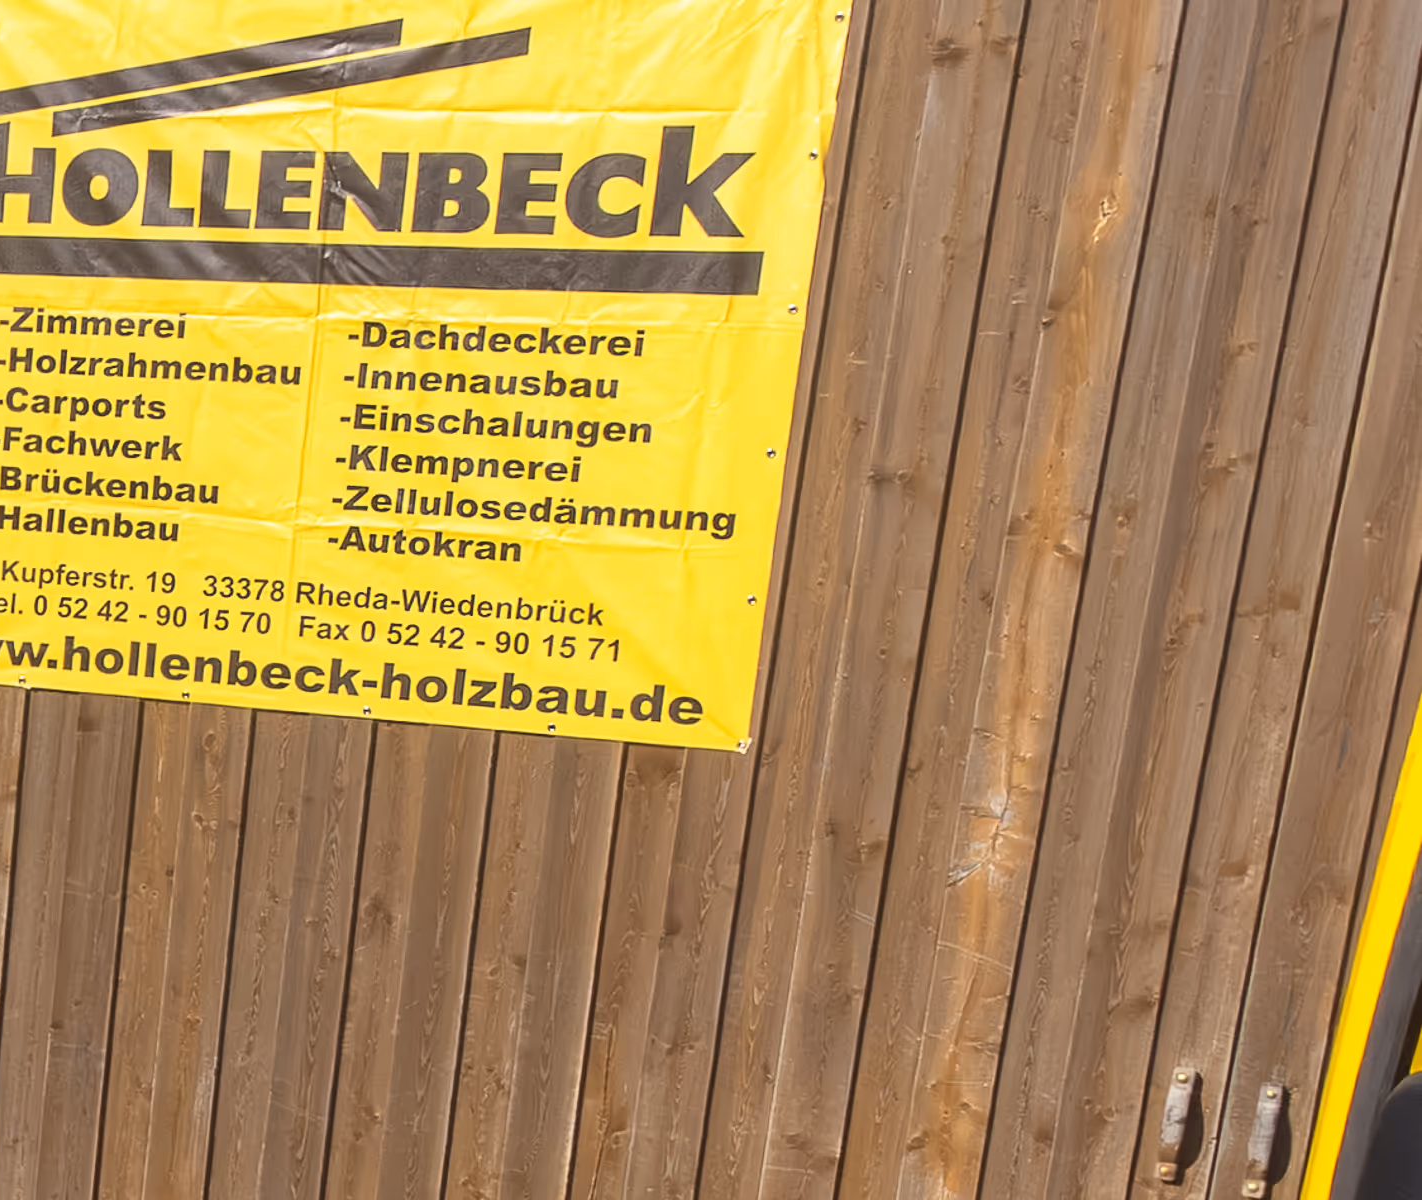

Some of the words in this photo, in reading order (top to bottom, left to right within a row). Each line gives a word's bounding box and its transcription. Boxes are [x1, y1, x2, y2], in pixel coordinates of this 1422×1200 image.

[0, 306, 187, 339] -Zimmerei
[347, 320, 646, 357] -Dachdeckerei
[343, 362, 619, 399] -Innenausbau
[339, 403, 652, 448] -Einschalungen
[335, 444, 582, 483] -Klempnerei
[331, 484, 737, 540] -Zellulosedämmung
[327, 525, 522, 562] -Autokran
[1, 559, 134, 591] Kupferstr.
[146, 570, 176, 594] 19
[202, 574, 285, 603] 33378
[295, 581, 604, 627] Rheda-Wiedenbrück
[33, 594, 48, 616] 0
[57, 596, 89, 620] 52
[96, 599, 129, 623] 42
[156, 604, 187, 628] 90
[199, 607, 230, 631] 15
[240, 611, 272, 635] 70
[298, 615, 350, 641] Fax
[360, 620, 376, 643] 0
[386, 622, 420, 647] 52
[429, 625, 465, 650] 42
[495, 630, 530, 655] 90
[542, 634, 577, 659] 15
[588, 637, 620, 663] 71
